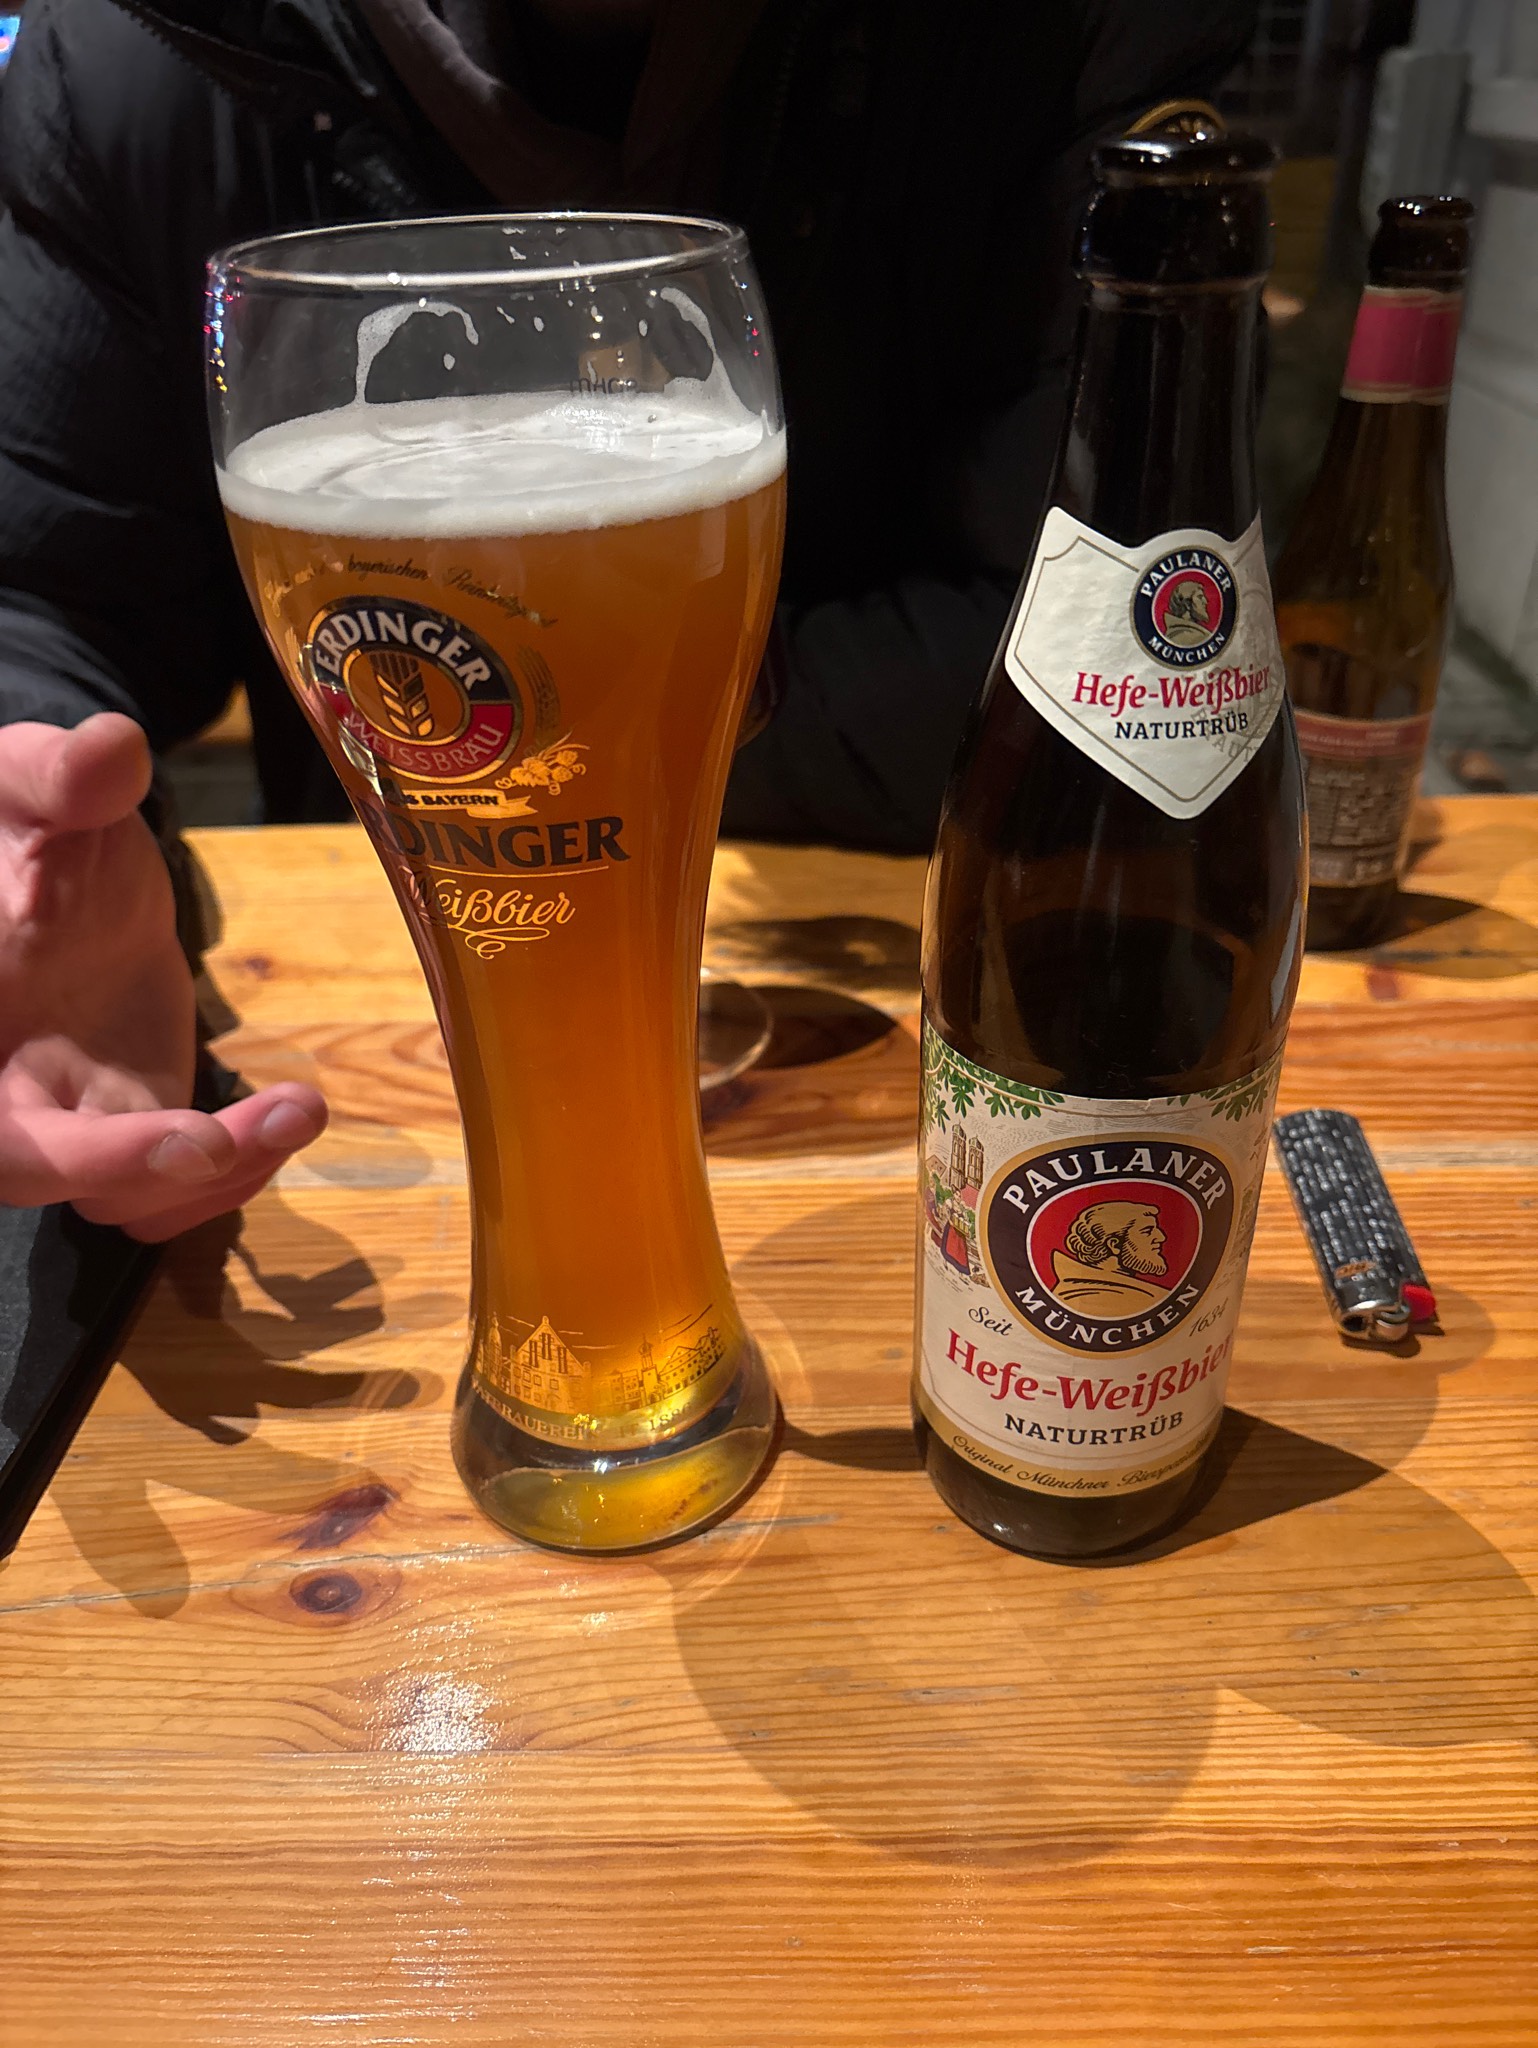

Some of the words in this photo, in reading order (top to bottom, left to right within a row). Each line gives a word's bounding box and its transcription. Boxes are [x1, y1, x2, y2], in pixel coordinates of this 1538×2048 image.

[1141, 552, 1232, 598] PAULANER
[315, 610, 491, 690] ERDINGER
[1072, 663, 1270, 717] Hefe-Weißbier
[345, 711, 505, 772] WEISSBRÄU
[1115, 712, 1249, 740] NATURTRÜB
[420, 794, 499, 805] BAYERN
[384, 816, 631, 868] DINGER
[412, 876, 577, 929] eißbier
[1002, 1147, 1227, 1214] PAULANER
[968, 1306, 1014, 1336] Seit
[1015, 1283, 1199, 1345] MÜNCHEN
[1005, 1411, 1184, 1445] NATURTRÜB
[953, 1435, 1013, 1474] Original
[1017, 1470, 1109, 1490] Münchner
